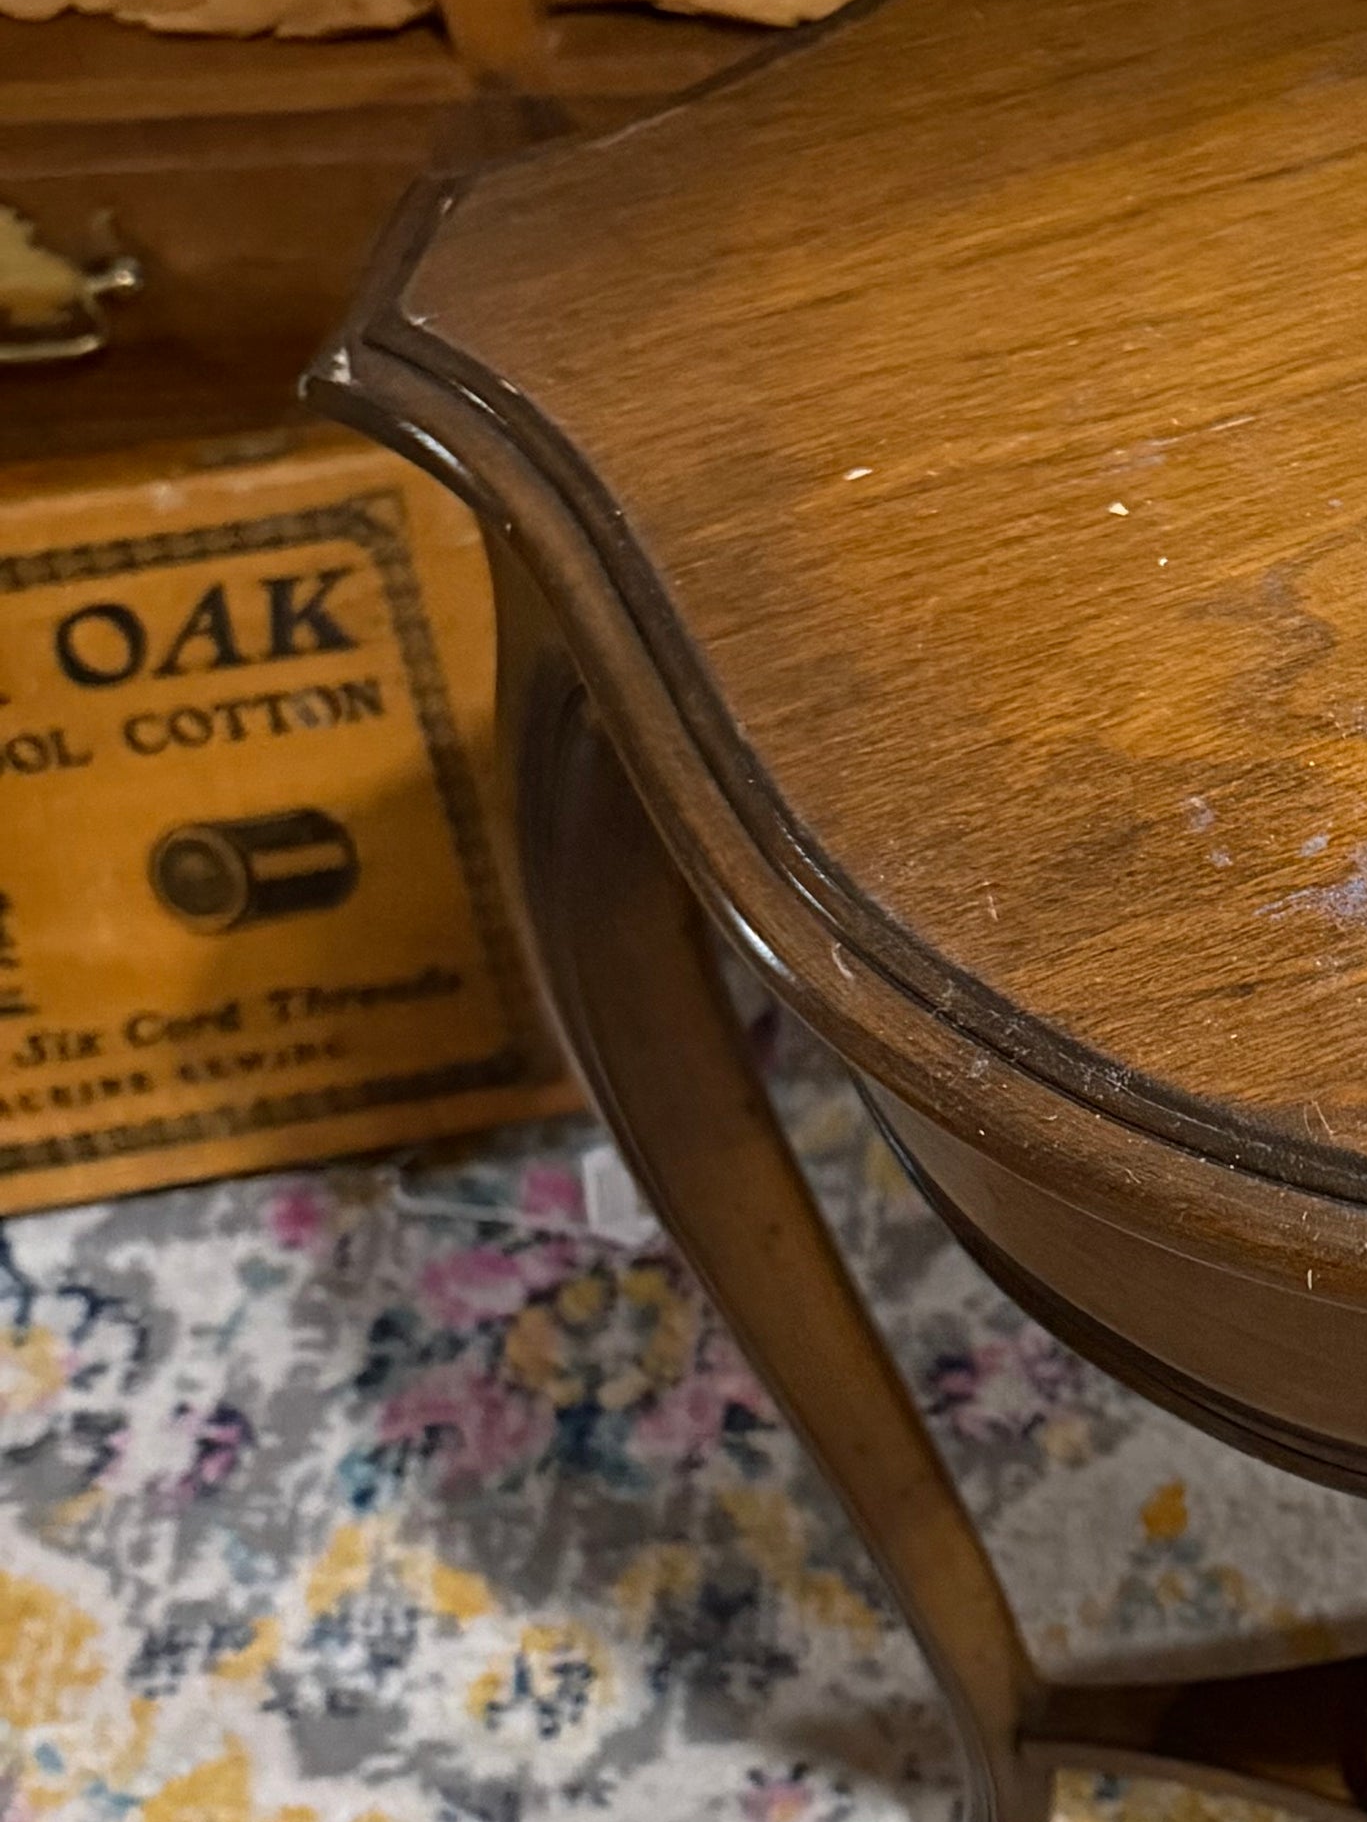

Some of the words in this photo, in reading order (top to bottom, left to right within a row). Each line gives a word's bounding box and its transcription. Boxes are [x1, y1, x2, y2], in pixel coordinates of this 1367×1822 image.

[55, 565, 360, 690] OAK
[0, 727, 94, 775] OL
[122, 677, 385, 758] COTTON
[11, 1028, 101, 1068] Six
